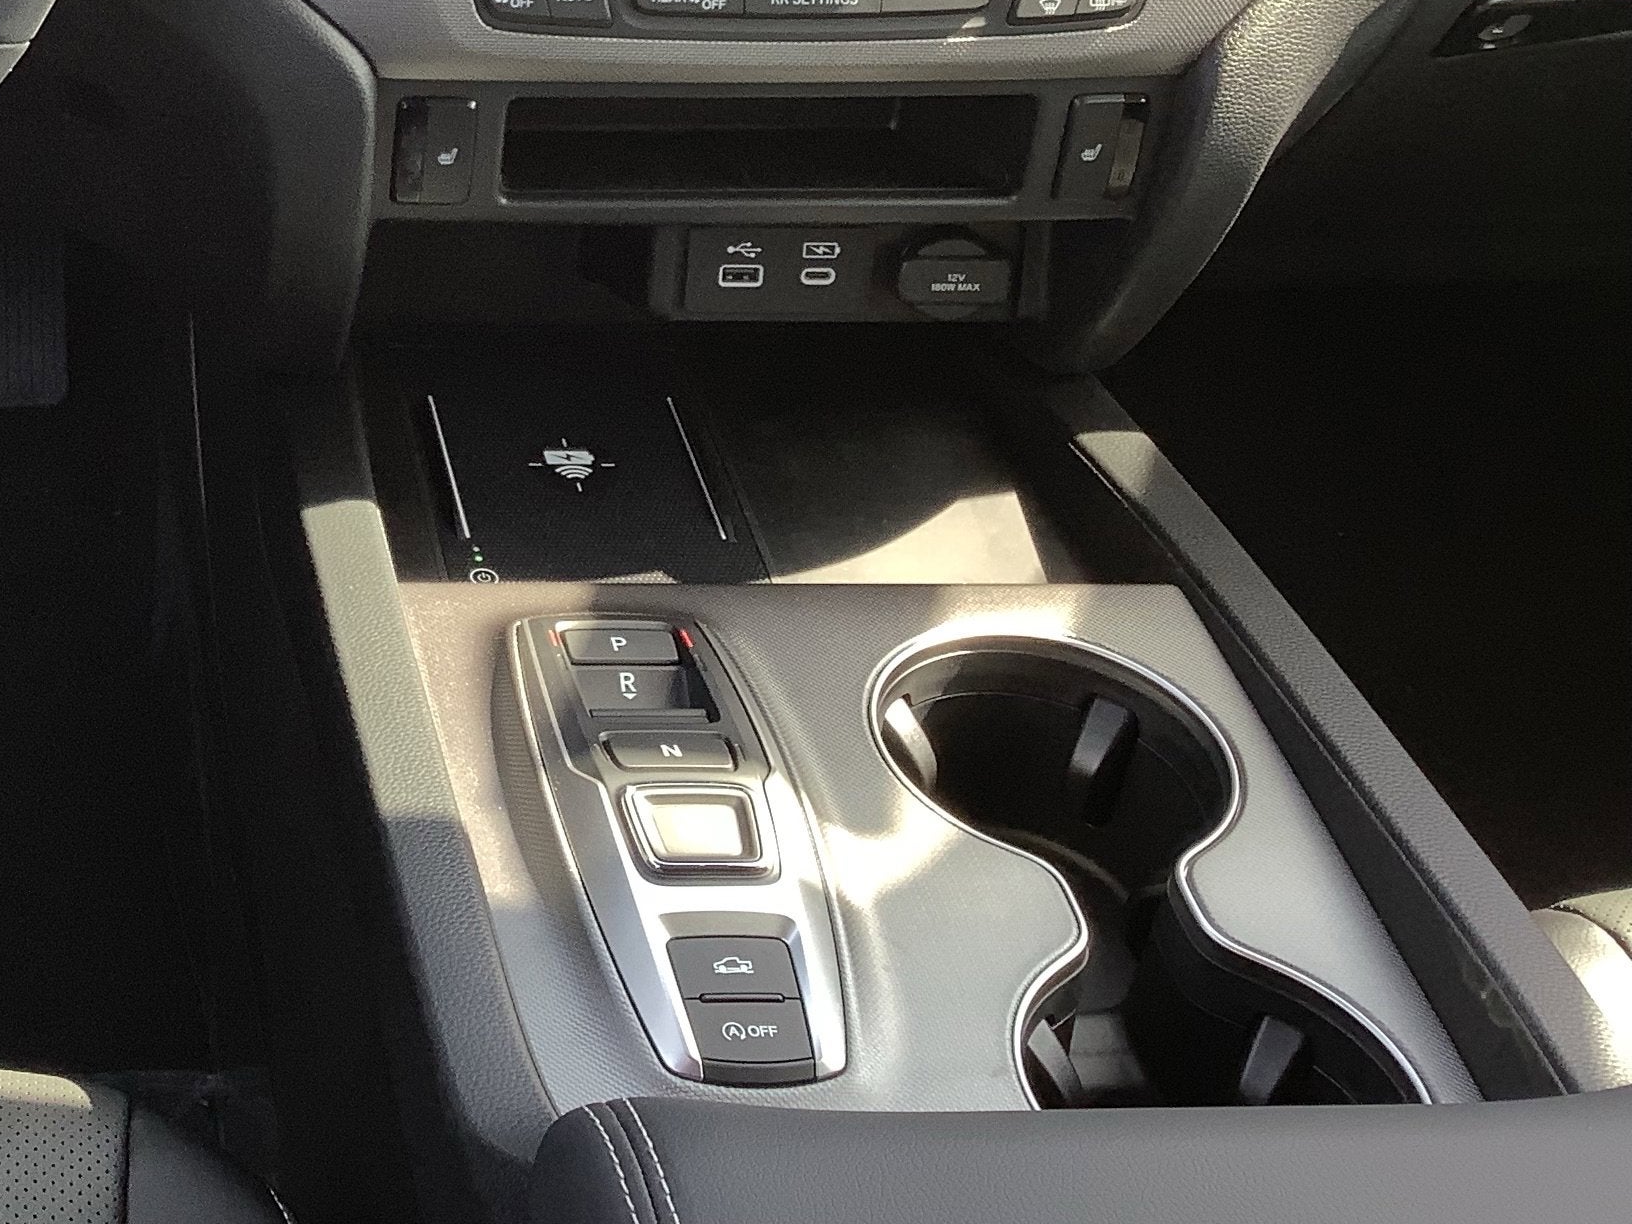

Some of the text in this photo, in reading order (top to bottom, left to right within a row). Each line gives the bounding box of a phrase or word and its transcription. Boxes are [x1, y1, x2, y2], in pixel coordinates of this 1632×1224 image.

[957, 283, 980, 292] MAX
[610, 636, 627, 651] P
[619, 672, 638, 693] R
[660, 744, 683, 758] N
[747, 1025, 778, 1038] OFF
